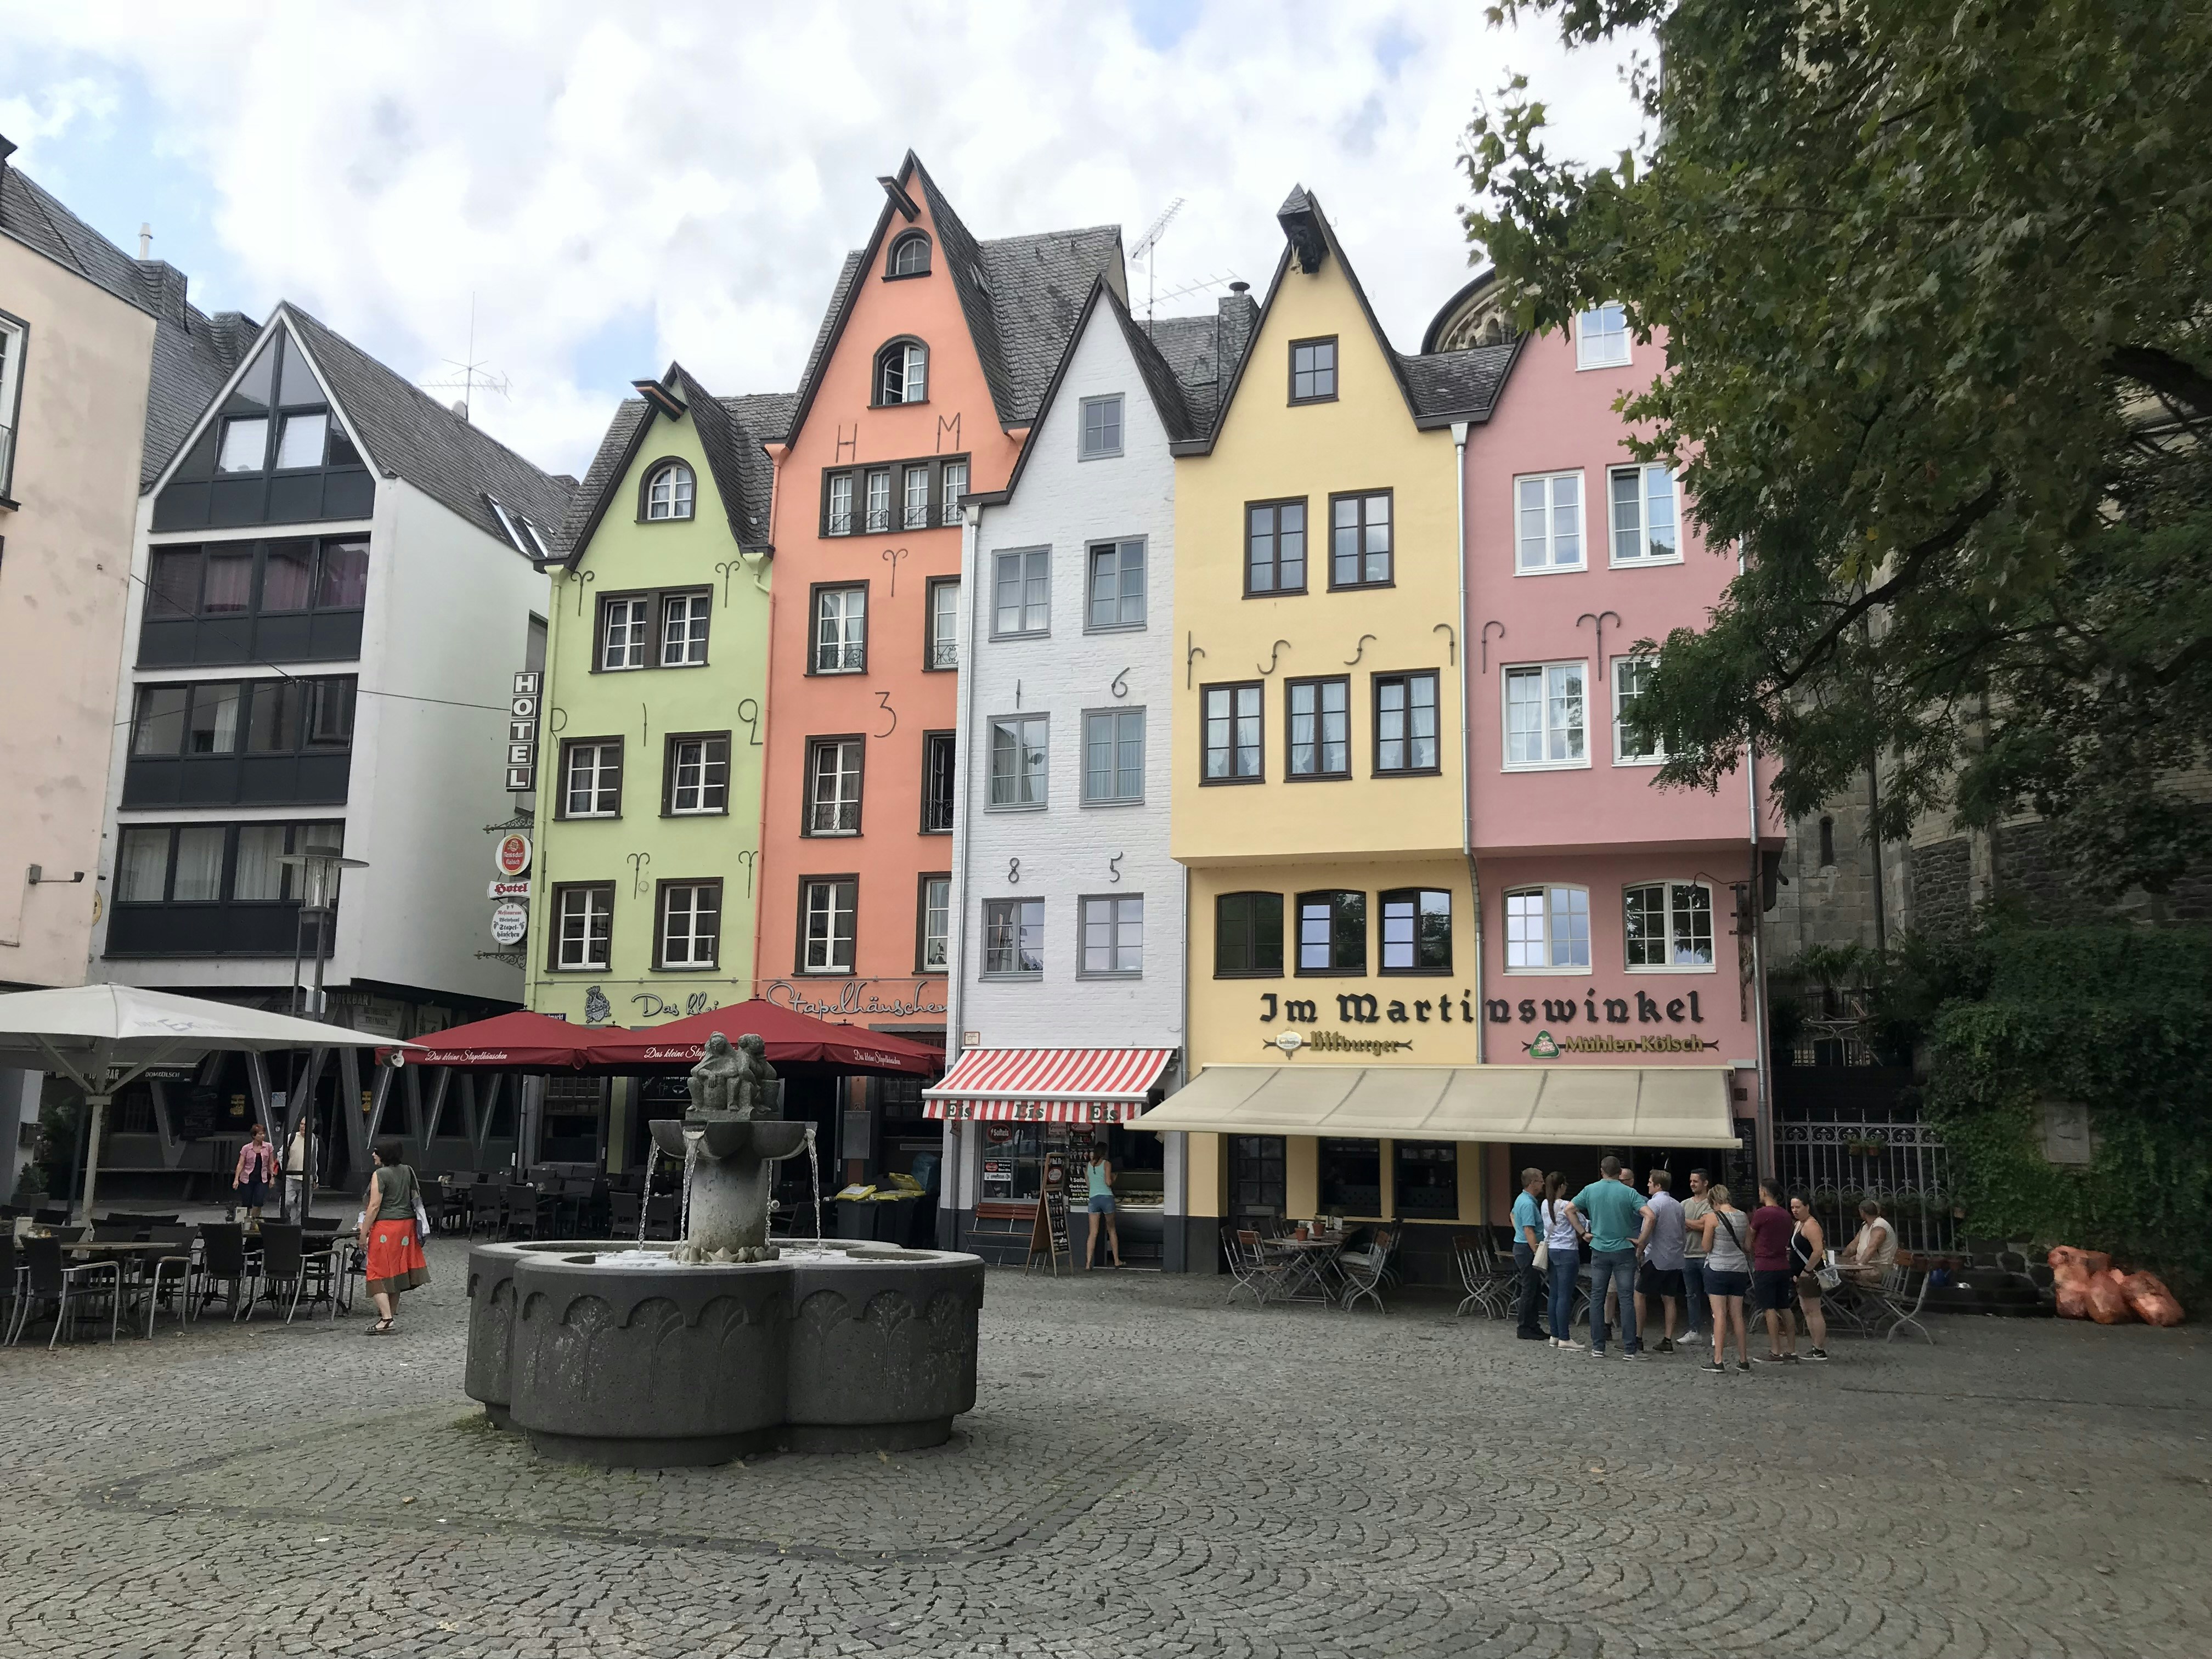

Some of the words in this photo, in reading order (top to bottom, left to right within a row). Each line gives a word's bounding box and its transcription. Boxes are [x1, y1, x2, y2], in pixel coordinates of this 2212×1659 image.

[509, 675, 537, 787] HOTEL
[494, 883, 528, 895] Hotel
[631, 992, 680, 1018] Das
[686, 991, 720, 1016] klei
[1259, 992, 1318, 1023] Im
[1336, 988, 1705, 1024] Martinswinkel
[1309, 1030, 1399, 1056] Bitburger
[1564, 1035, 1637, 1052] Mühlen
[1640, 1034, 1704, 1052] Kölsch
[425, 1050, 441, 1061] Das
[442, 1052, 460, 1061] kleine
[460, 1049, 507, 1063] Stapelhäuschen
[644, 1047, 663, 1058] Das
[663, 1048, 685, 1058] kleine
[685, 1045, 707, 1060] Stap
[853, 1049, 864, 1060] Das
[865, 1052, 874, 1062] kleine
[874, 1051, 901, 1066] Stapelhäuschen
[945, 1103, 973, 1118] Eis
[1014, 1103, 1045, 1119] Eis
[1090, 1105, 1119, 1121] Eis
